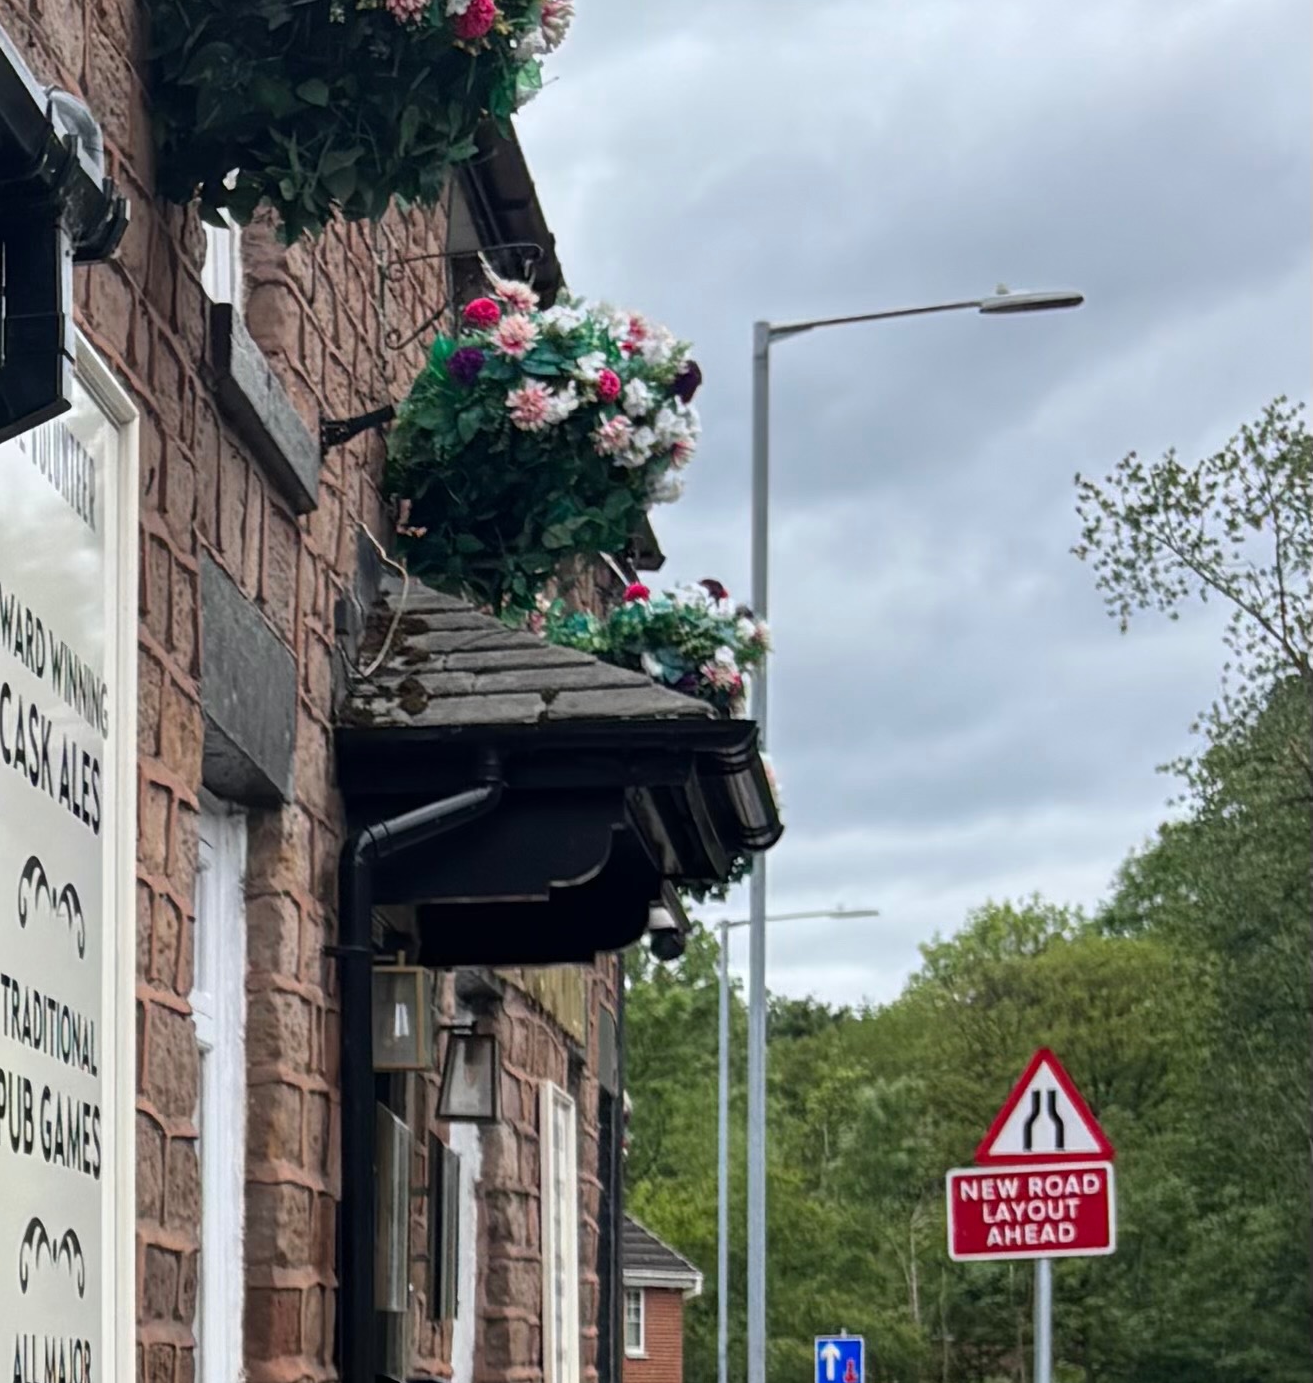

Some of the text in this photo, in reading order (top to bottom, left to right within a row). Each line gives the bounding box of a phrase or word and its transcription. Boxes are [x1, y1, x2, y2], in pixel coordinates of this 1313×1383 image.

[49, 628, 109, 741] WINNING
[0, 681, 101, 836] CASK ALES
[0, 971, 98, 1078] TRADITIONAL
[39, 1084, 101, 1181] GAMES
[960, 1172, 1101, 1202] NEW ROAD
[982, 1197, 1081, 1224] LAYOUT
[986, 1221, 1077, 1247] AHEAD
